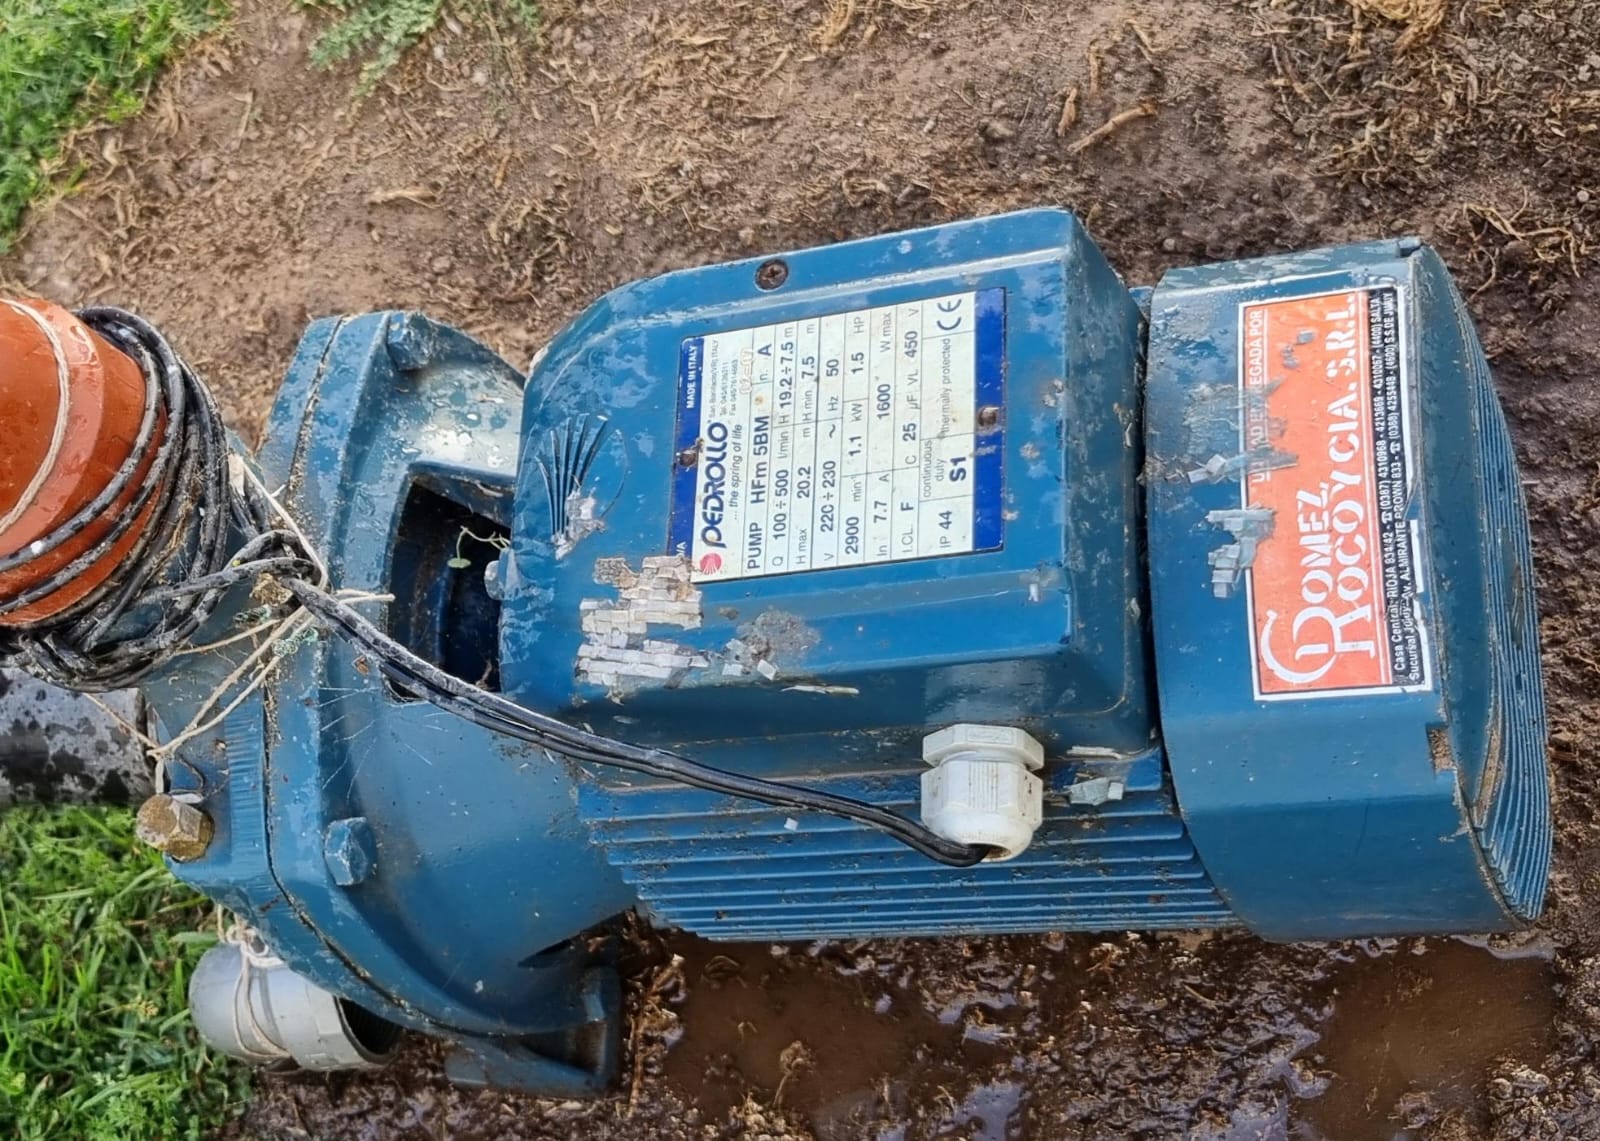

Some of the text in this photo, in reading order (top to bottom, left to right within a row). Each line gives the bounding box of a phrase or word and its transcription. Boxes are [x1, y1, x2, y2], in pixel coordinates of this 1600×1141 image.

[908, 308, 919, 316] V
[1370, 297, 1381, 322] SALTA
[806, 324, 814, 333] m
[1249, 310, 1262, 336] POR
[1370, 324, 1383, 348] (4400)
[757, 344, 772, 356] A
[851, 316, 864, 374] 1.5 HP
[904, 331, 918, 358] 450
[687, 345, 697, 408] MADE IN ITALY
[779, 415, 790, 424] H
[785, 327, 793, 337] m
[802, 356, 815, 379] 7.5
[877, 312, 891, 419] 1600 W max
[826, 359, 839, 411] Hz 50
[940, 338, 952, 433] thermally protected
[804, 390, 812, 409] min
[732, 425, 742, 440] life
[848, 403, 863, 456] 1.1 kW
[902, 423, 916, 442] 25
[1326, 382, 1359, 463] CIA.
[731, 441, 741, 452] of
[730, 456, 742, 488] spring
[905, 455, 916, 465] C
[921, 440, 932, 497] continuous
[935, 459, 947, 481] duty
[949, 456, 967, 482] S1
[1391, 462, 1401, 478] 833
[700, 422, 728, 548] PEDROLLO
[775, 470, 789, 497] 500
[822, 461, 836, 488] 230
[879, 474, 890, 482] A
[729, 491, 738, 507] the
[747, 415, 769, 569] PUMP HFm 5BM
[796, 428, 811, 564] H max 20.2 m
[1379, 480, 1392, 509] (0387)
[820, 504, 834, 532] 220
[873, 501, 887, 523] 7.7
[900, 502, 914, 511] F
[773, 514, 786, 540] 100
[845, 517, 859, 554] 2900
[939, 511, 952, 548] IP 44
[772, 556, 783, 566] Q
[824, 553, 834, 561] V
[1395, 521, 1410, 580] ALMIRANTE
[1385, 566, 1398, 597] RIOJA
[1394, 645, 1405, 671] Casa
[1405, 635, 1420, 680] Sucursal
